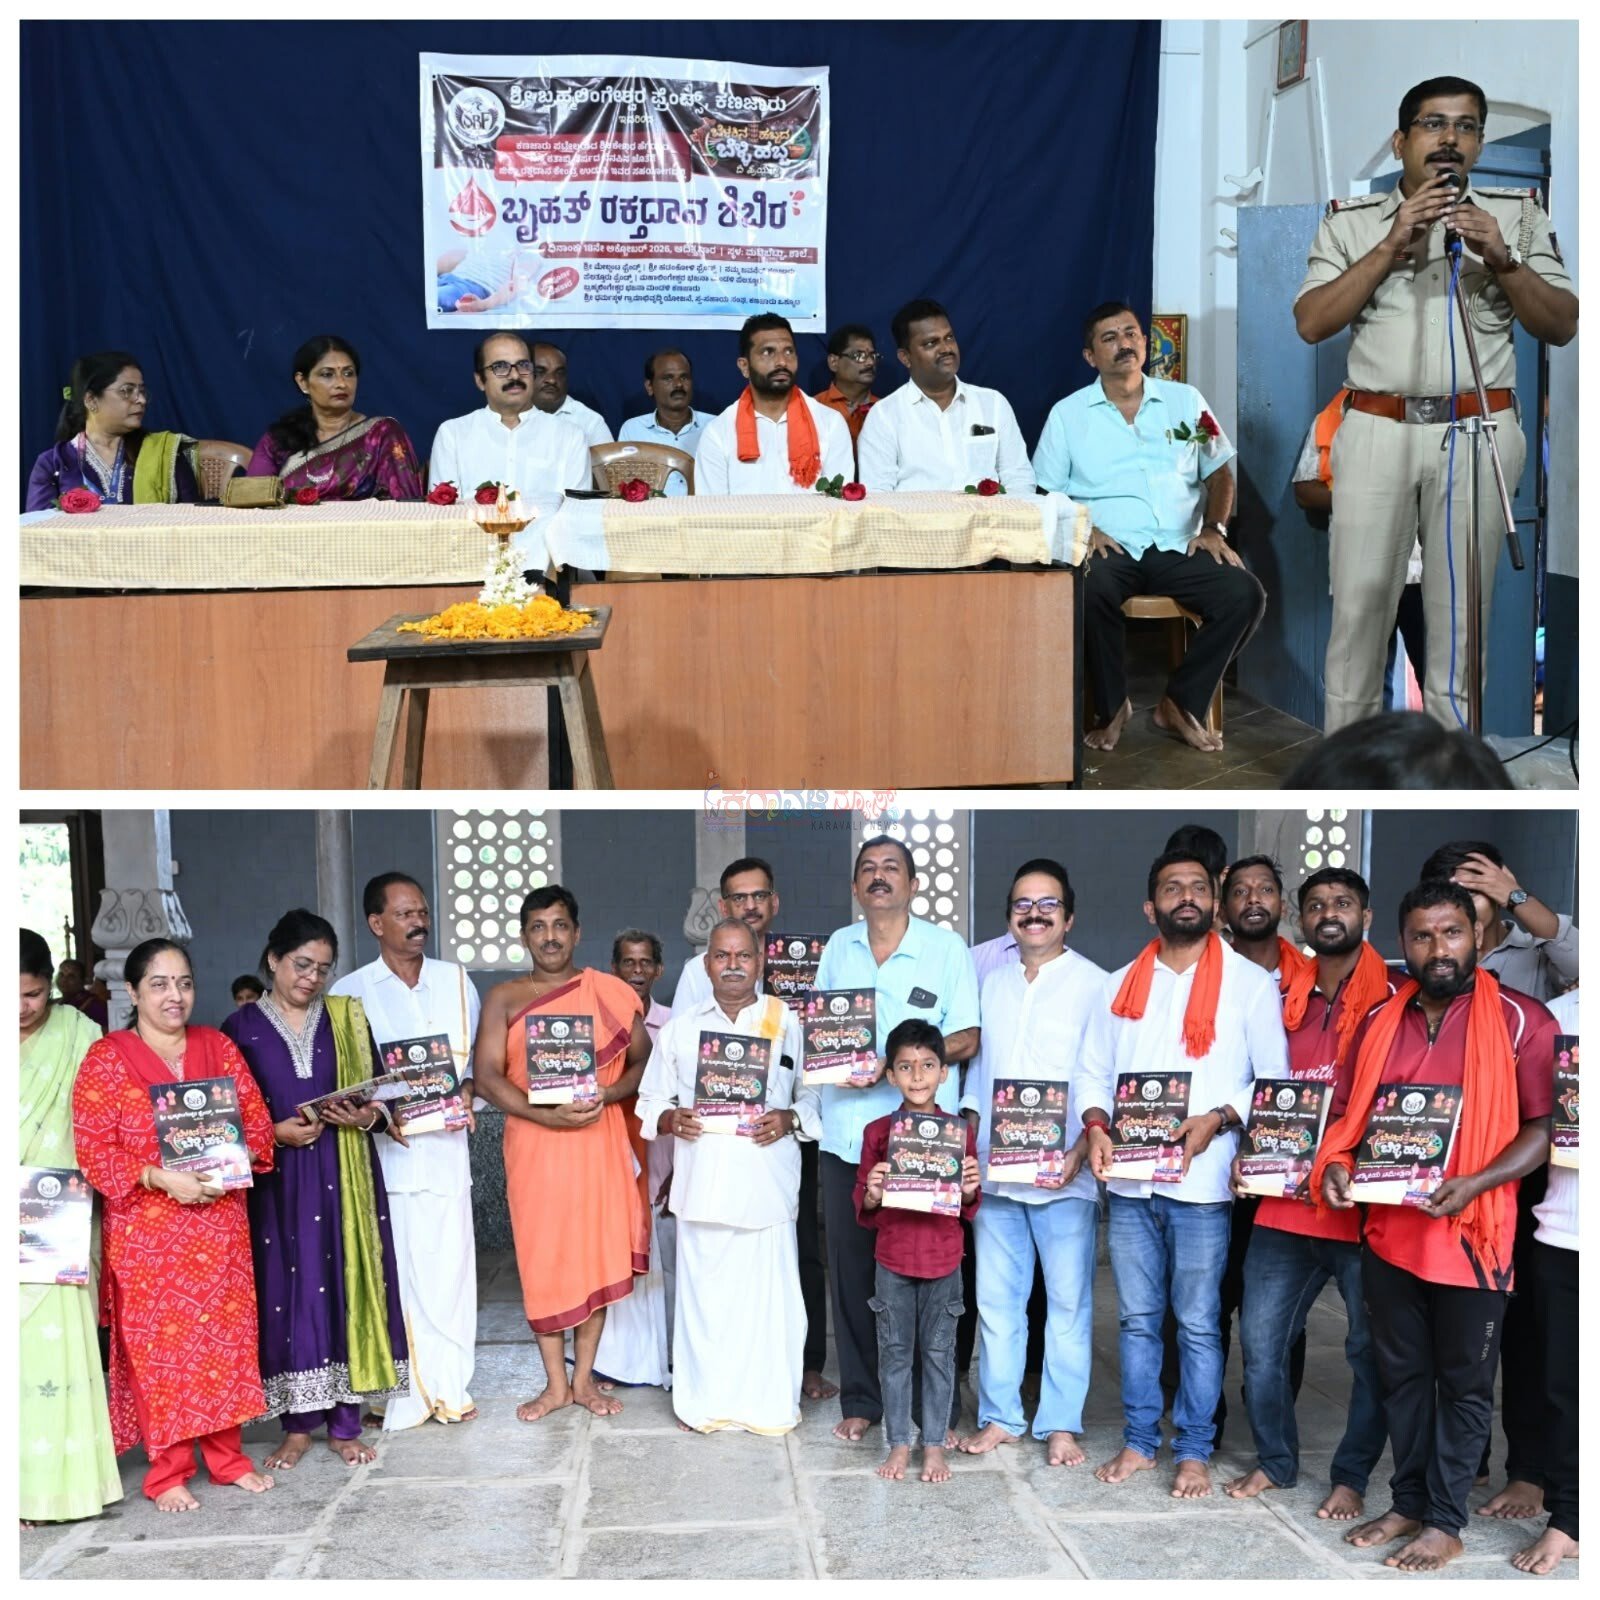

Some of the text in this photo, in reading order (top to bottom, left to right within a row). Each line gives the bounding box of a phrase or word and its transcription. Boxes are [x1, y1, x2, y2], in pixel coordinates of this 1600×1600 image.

[716, 95, 786, 112] ಕಣಜಾರು
[716, 138, 791, 167] ಬೆಳ್ಳಿ ಹಬ್ಬ
[502, 185, 787, 244] ಬೃಹತ್ ರಕ್ತದಾನ ಶಿಬಿರ
